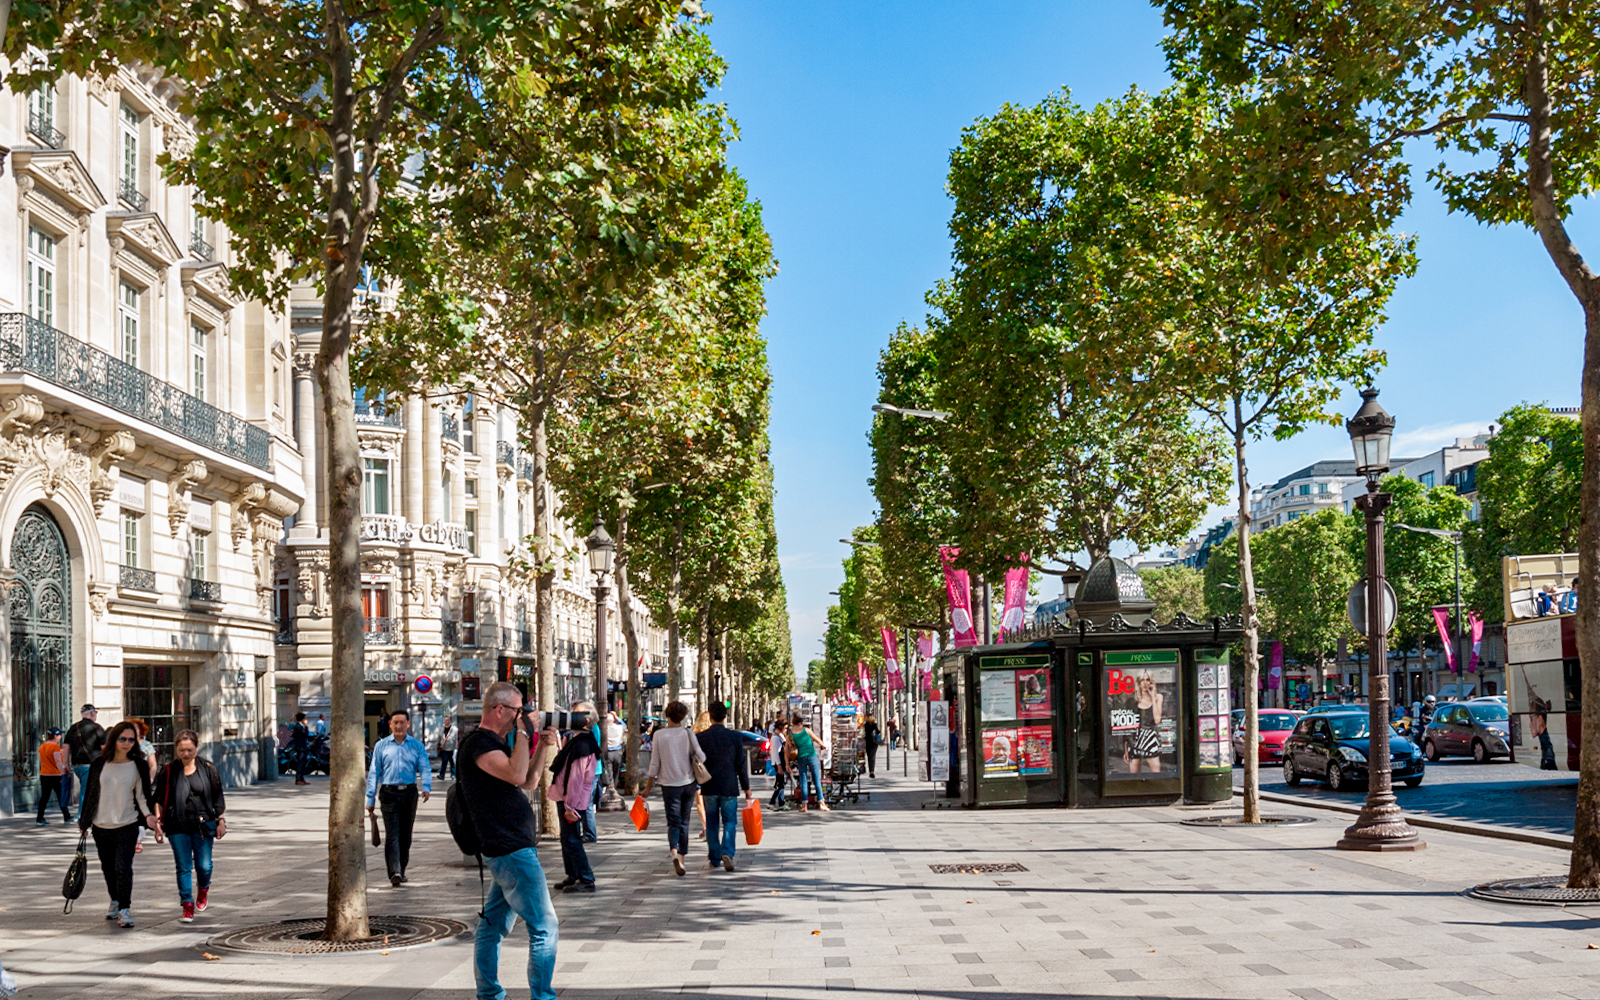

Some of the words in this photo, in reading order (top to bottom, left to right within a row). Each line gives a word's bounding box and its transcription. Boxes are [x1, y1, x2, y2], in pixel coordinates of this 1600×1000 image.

[1003, 657, 1027, 665] PRESSE
[364, 672, 398, 681] watch
[1107, 668, 1135, 695] Be
[1111, 714, 1140, 726] MODE
